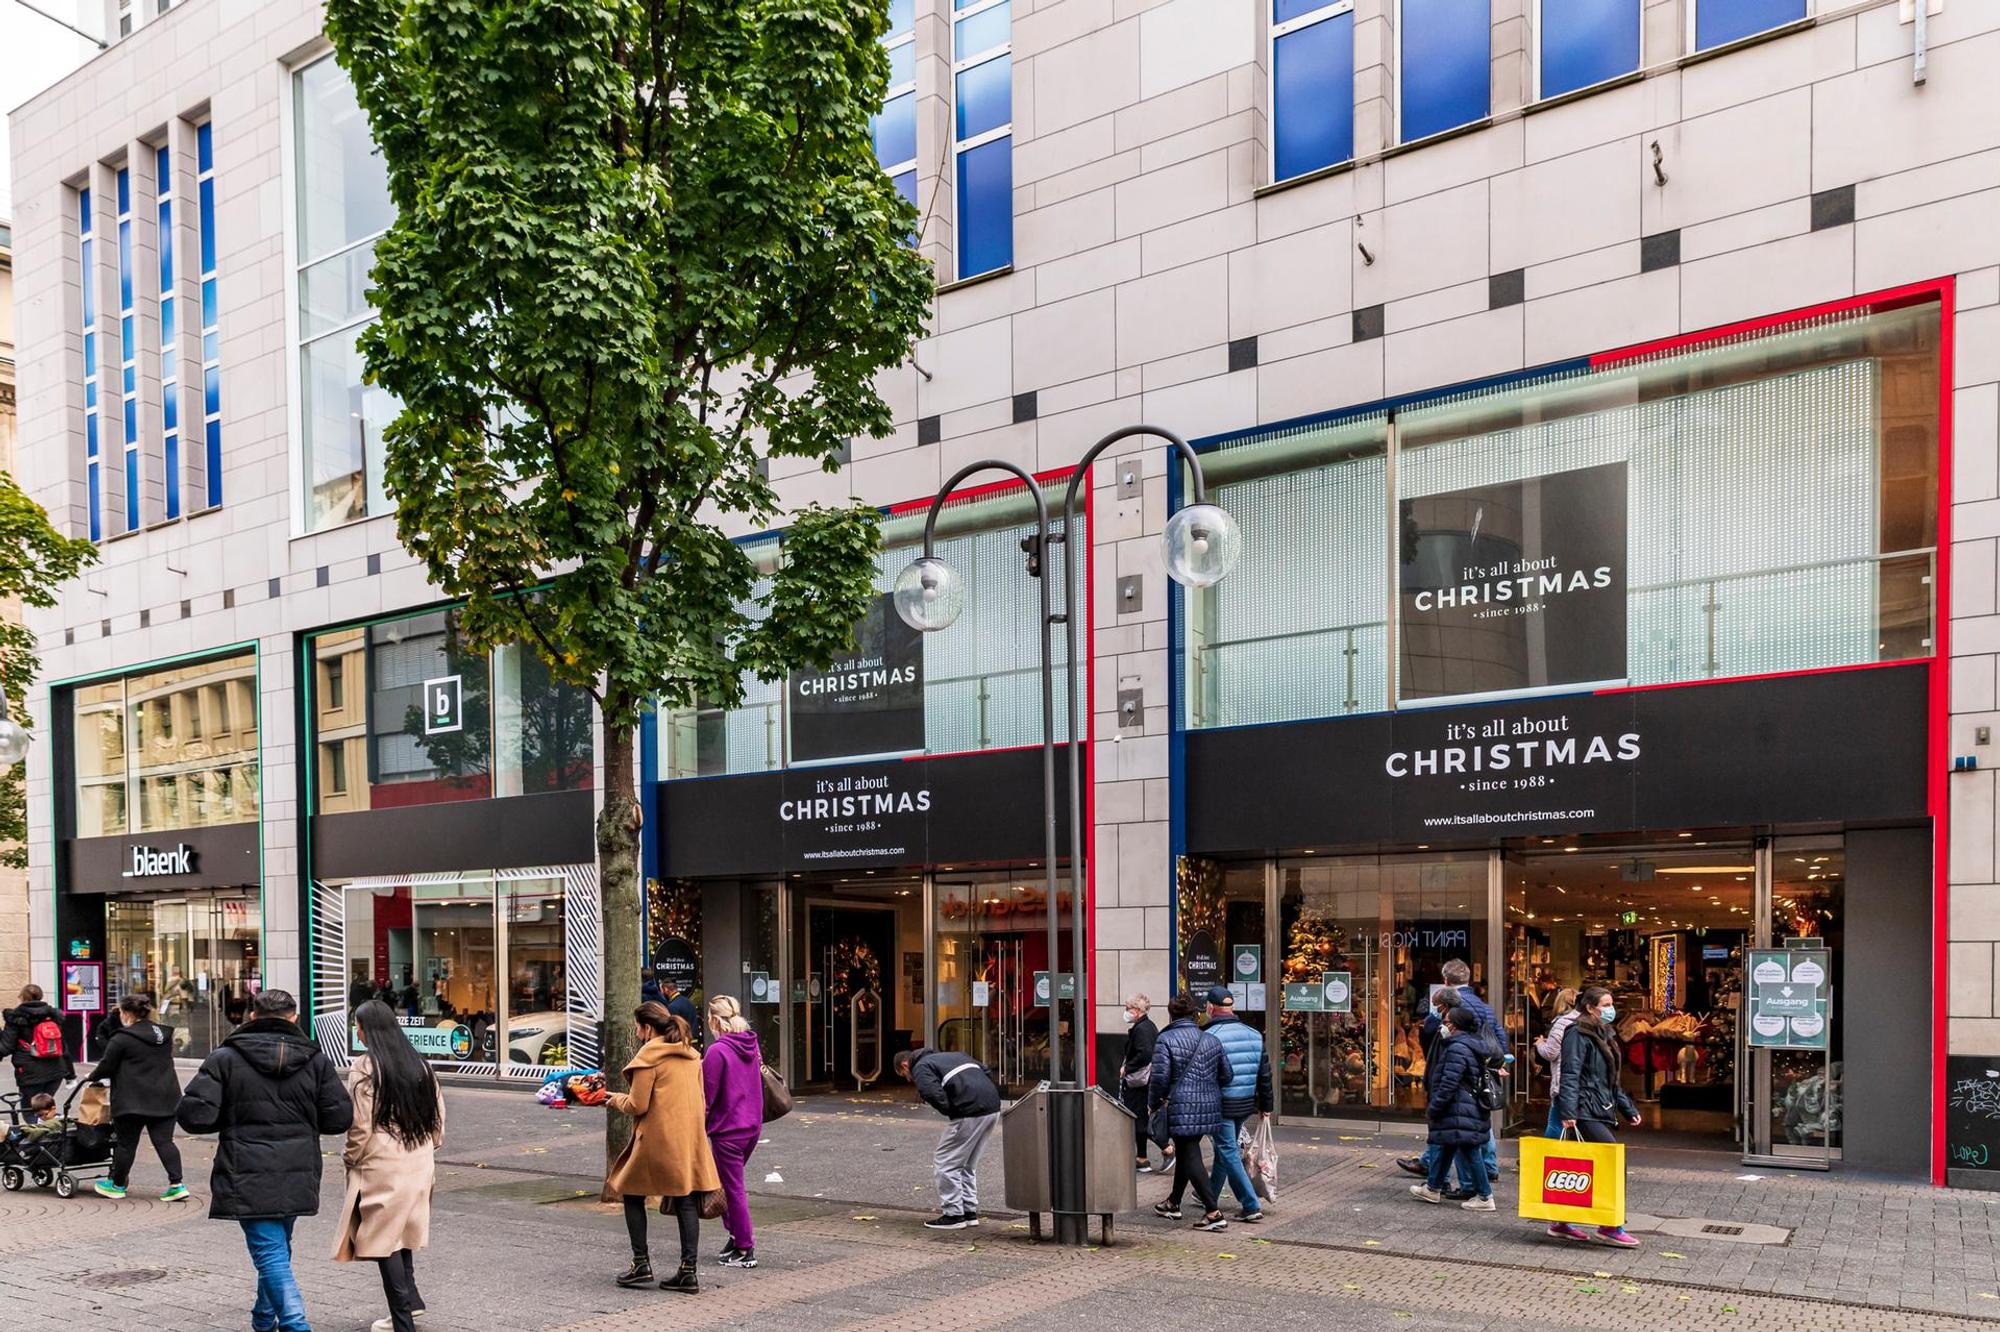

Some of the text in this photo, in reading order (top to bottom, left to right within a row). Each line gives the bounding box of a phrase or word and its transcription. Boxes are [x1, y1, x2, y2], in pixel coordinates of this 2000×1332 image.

[1463, 555, 1557, 581] it's all about
[1415, 566, 1612, 611] CHRISTMAS
[1479, 603, 1540, 619] since 1988
[828, 656, 883, 673] t's all about
[800, 665, 916, 696] CHRISTMAS
[1447, 715, 1569, 741] it's all about
[1385, 733, 1641, 778] CHRISTMAS
[816, 775, 889, 794] it's all about
[1468, 775, 1546, 792] since 1988
[779, 790, 931, 821] CHRISTMAS
[1424, 808, 1595, 826] www.itsallaboutchristmas.com
[829, 821, 876, 833] since 1988
[803, 846, 905, 859] www.itsallaboutchristmas.com
[1188, 961, 1217, 970] CHRISTMAS
[1289, 994, 1319, 1004] Ausgang
[1766, 997, 1809, 1007] Ausgang
[410, 1016, 426, 1026] ZEIT
[1546, 1170, 1590, 1192] LEGO
